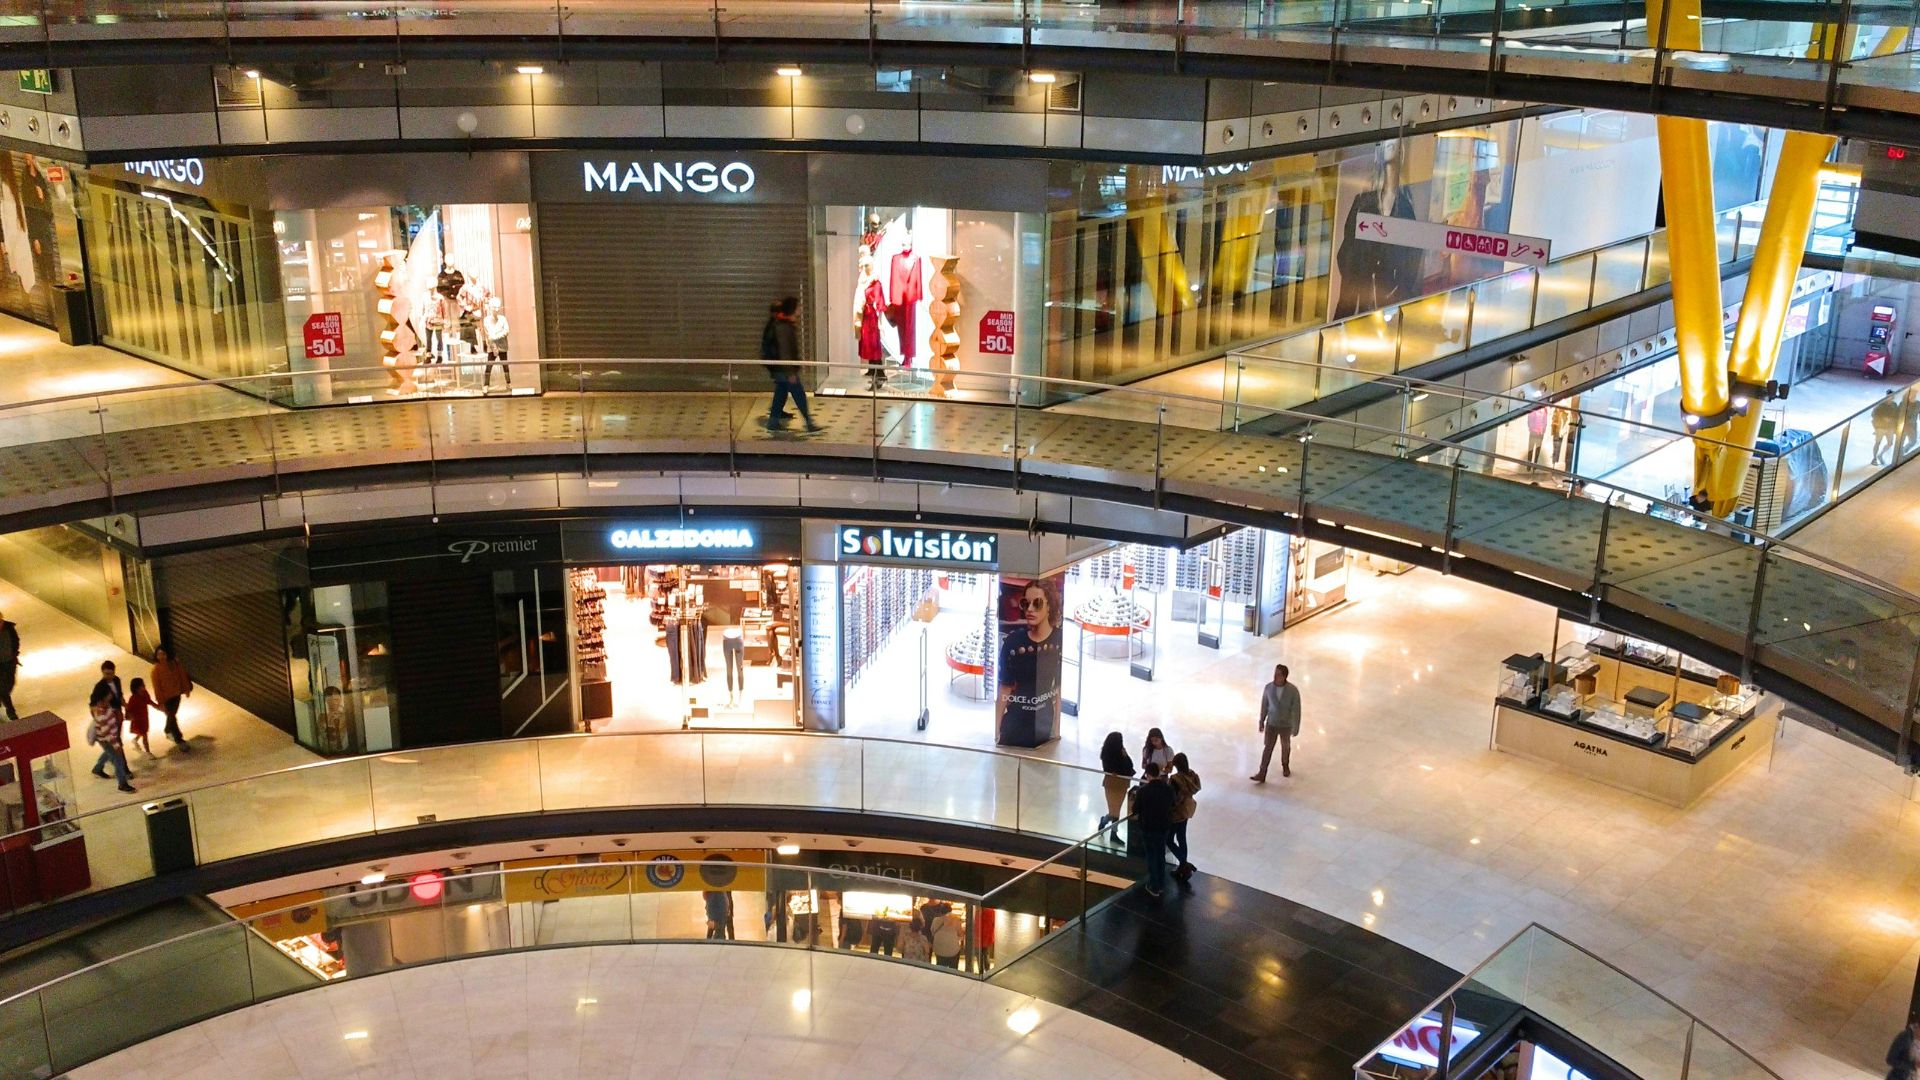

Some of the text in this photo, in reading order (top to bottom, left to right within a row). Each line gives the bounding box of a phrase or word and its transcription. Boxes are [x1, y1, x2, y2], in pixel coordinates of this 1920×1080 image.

[583, 162, 755, 193] MANGO
[311, 322, 340, 330] SEASON
[610, 529, 754, 549] CALZEDONIA
[843, 528, 992, 562] Solvisión
[448, 536, 538, 563] Premier
[1002, 695, 1027, 704] DOLCE
[1573, 741, 1608, 757] AGATHA
